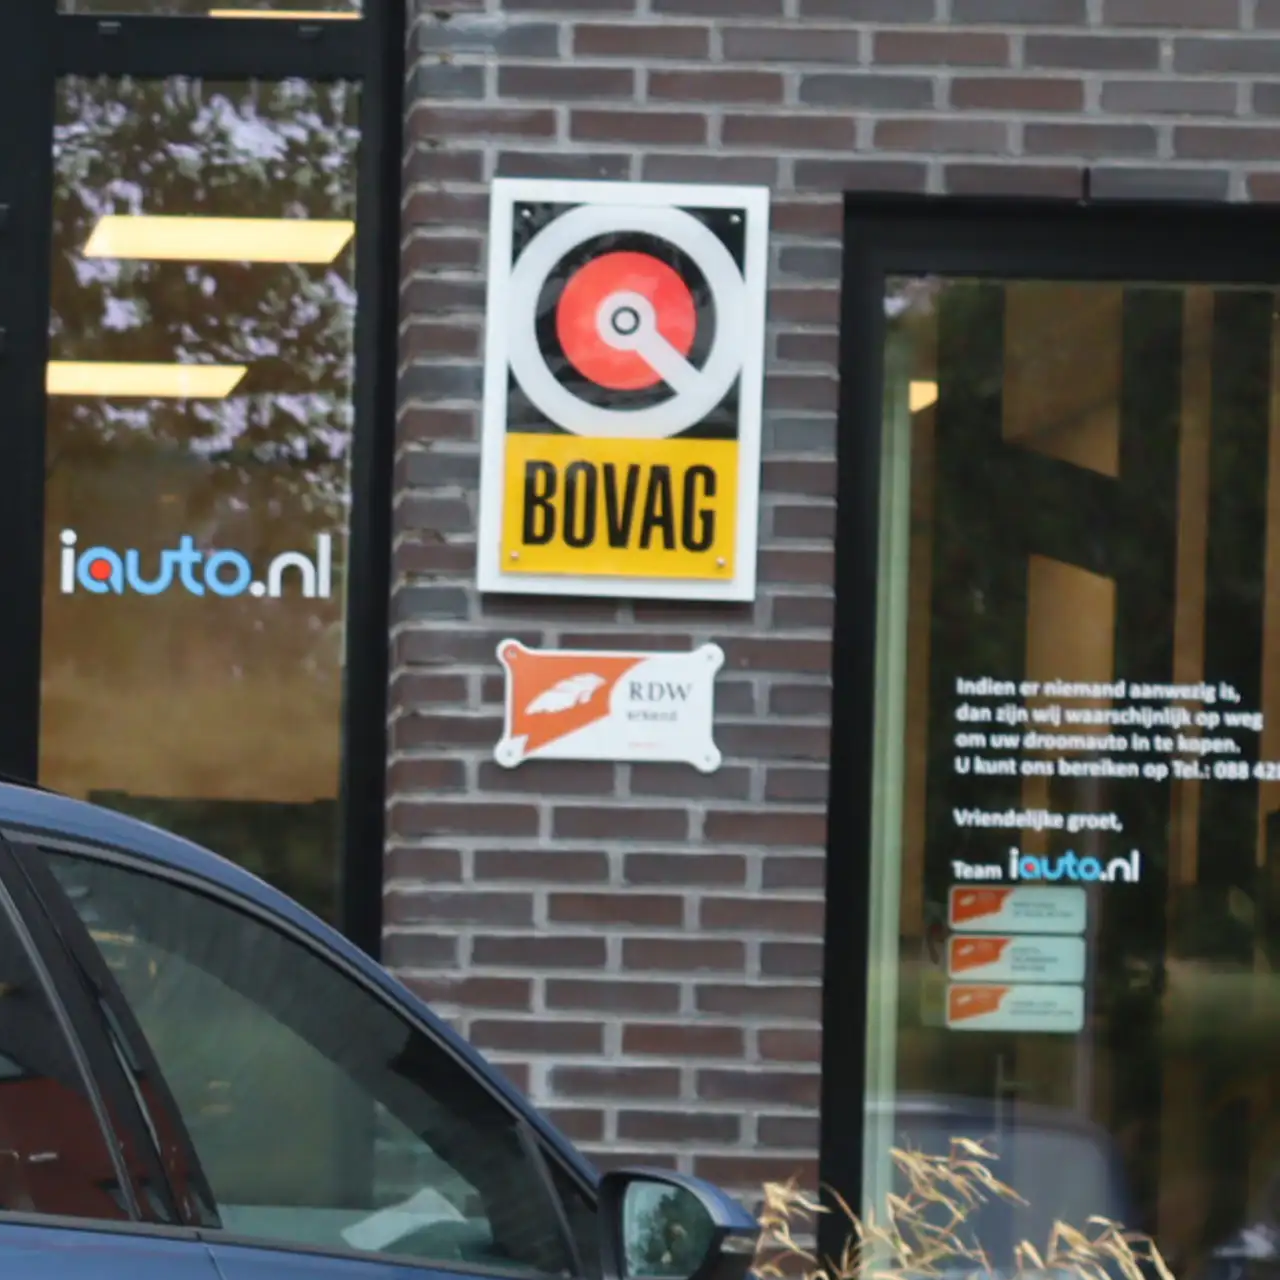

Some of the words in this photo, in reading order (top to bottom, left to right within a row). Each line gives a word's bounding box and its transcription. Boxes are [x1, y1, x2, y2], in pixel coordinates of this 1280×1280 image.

[521, 459, 717, 553] BOVAG
[61, 530, 330, 598] iauto.nl
[628, 681, 694, 701] RDW
[957, 678, 1015, 695] Indien
[1019, 682, 1040, 696] er
[1043, 678, 1125, 699] niemand
[1130, 682, 1216, 703] aanwezig
[956, 704, 991, 721] dan
[996, 705, 1028, 725] zijn
[1032, 705, 1061, 727] wij
[1064, 704, 1191, 730] waarschijnlijk
[1195, 712, 1220, 728] op
[1224, 713, 1263, 730] weg
[955, 734, 986, 747] om
[990, 735, 1020, 748] uw
[1023, 729, 1127, 750] droomauto
[1132, 734, 1149, 750] in
[1154, 736, 1173, 751] te
[1177, 734, 1240, 755] kopen.
[955, 757, 970, 773] U
[974, 756, 1016, 774] kunt
[1021, 761, 1054, 775] ons
[1058, 758, 1139, 776] bereiken
[1143, 764, 1168, 780] op
[954, 809, 1064, 832] Vriendelijke
[1067, 814, 1122, 832] groet,
[953, 861, 1002, 878] Team
[1008, 847, 1141, 882] iauto.nl
